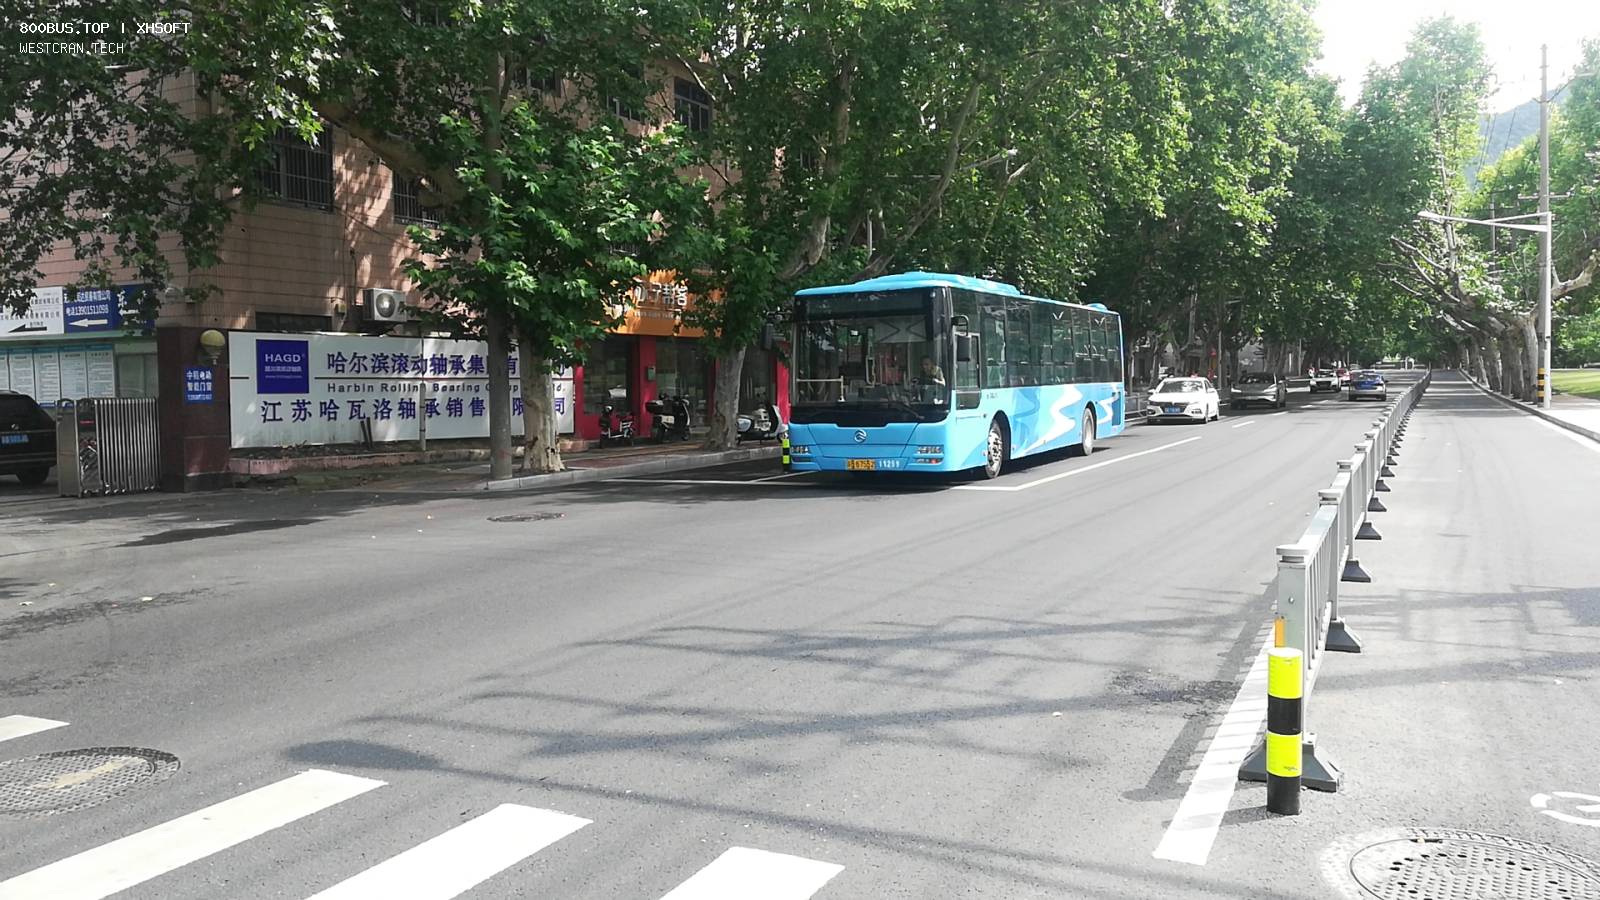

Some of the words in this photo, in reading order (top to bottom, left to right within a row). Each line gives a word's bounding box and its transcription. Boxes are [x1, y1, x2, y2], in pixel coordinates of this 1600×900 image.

[264, 353, 302, 363] HAGD
[327, 383, 374, 393] Harbin
[380, 383, 420, 393] Rollin
[433, 383, 480, 393] Bearing
[261, 397, 566, 423] 江苏哈瓦洛轴承销售限司
